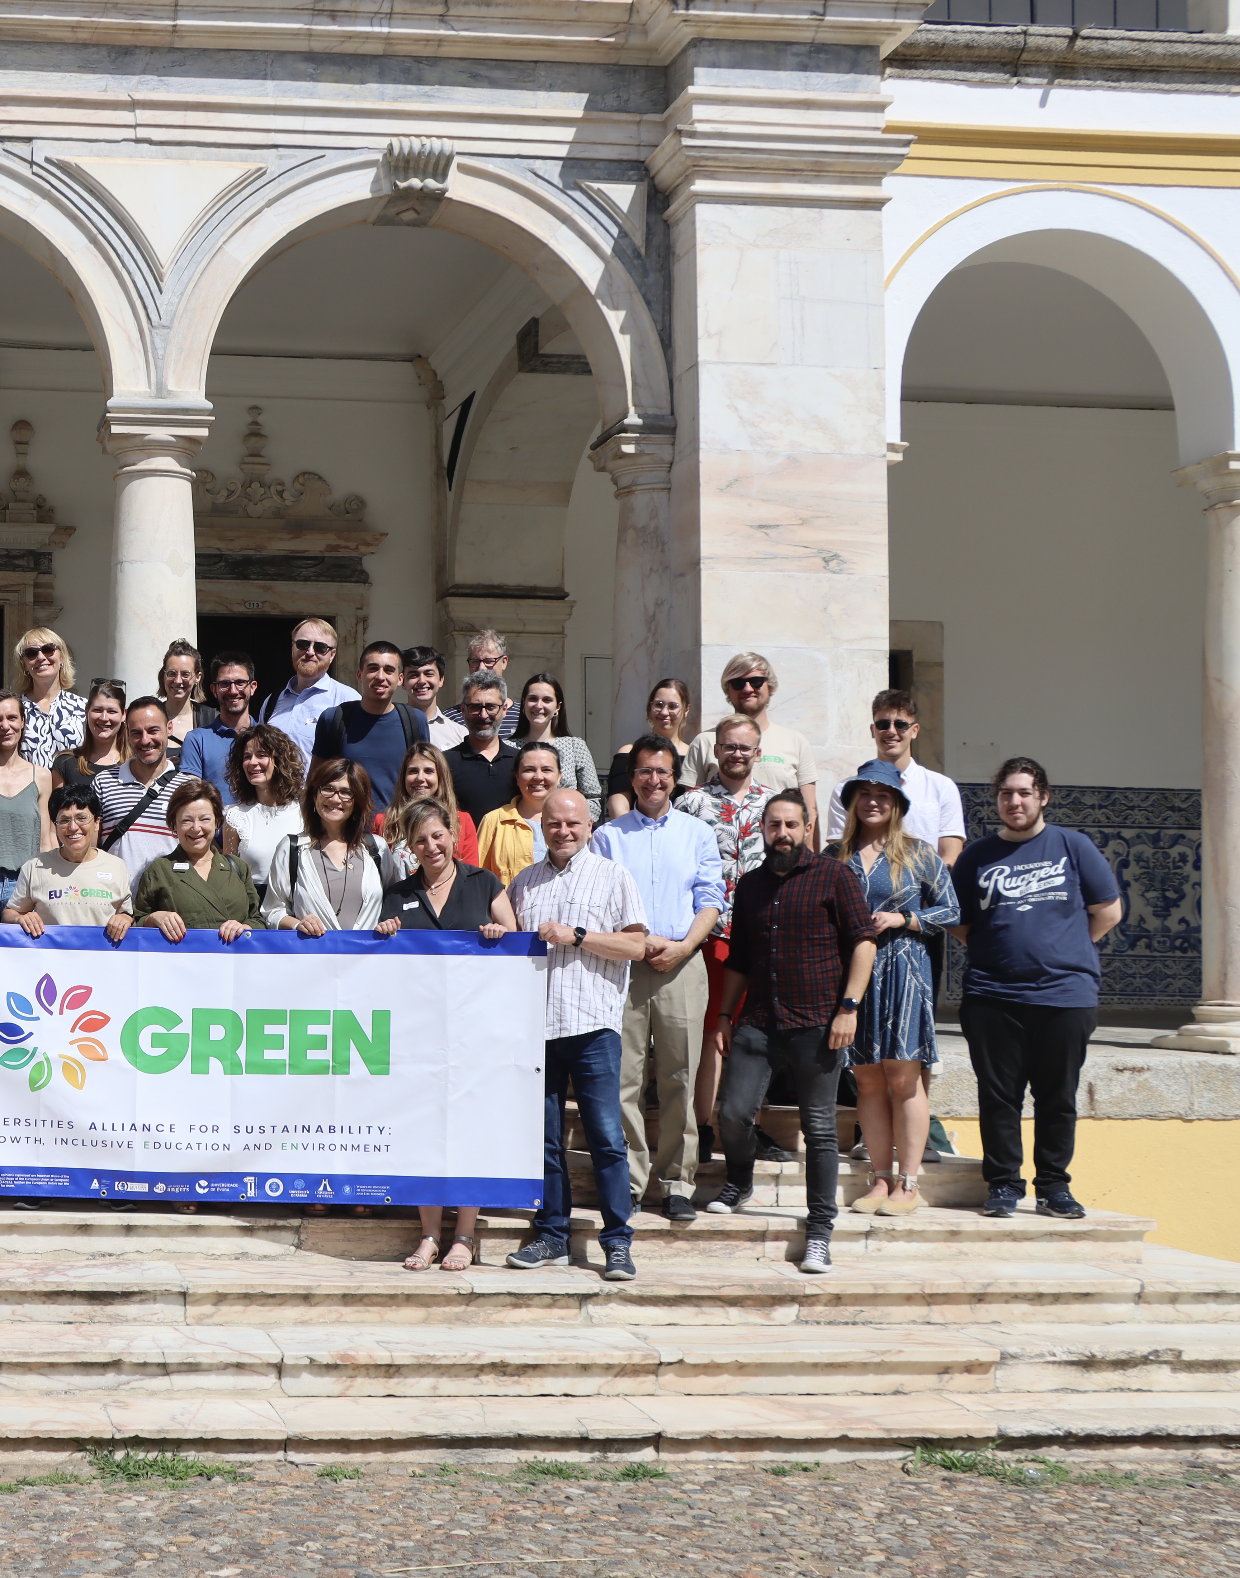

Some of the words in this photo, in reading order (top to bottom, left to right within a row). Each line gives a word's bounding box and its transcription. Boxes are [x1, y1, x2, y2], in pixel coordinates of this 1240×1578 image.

[978, 856, 1068, 911] Rugged
[48, 889, 63, 900] EU
[80, 888, 113, 900] GREEN
[119, 1006, 391, 1076] GREEN
[88, 1121, 176, 1133] ALLIANCE
[189, 1124, 220, 1134] FOR
[233, 1124, 392, 1136] SUSTAINABILITY:
[54, 1137, 134, 1149] INCLUSIVE
[143, 1140, 231, 1152] EDUCATION
[242, 1142, 273, 1152] AND
[281, 1142, 392, 1153] ENVIRONMENT
